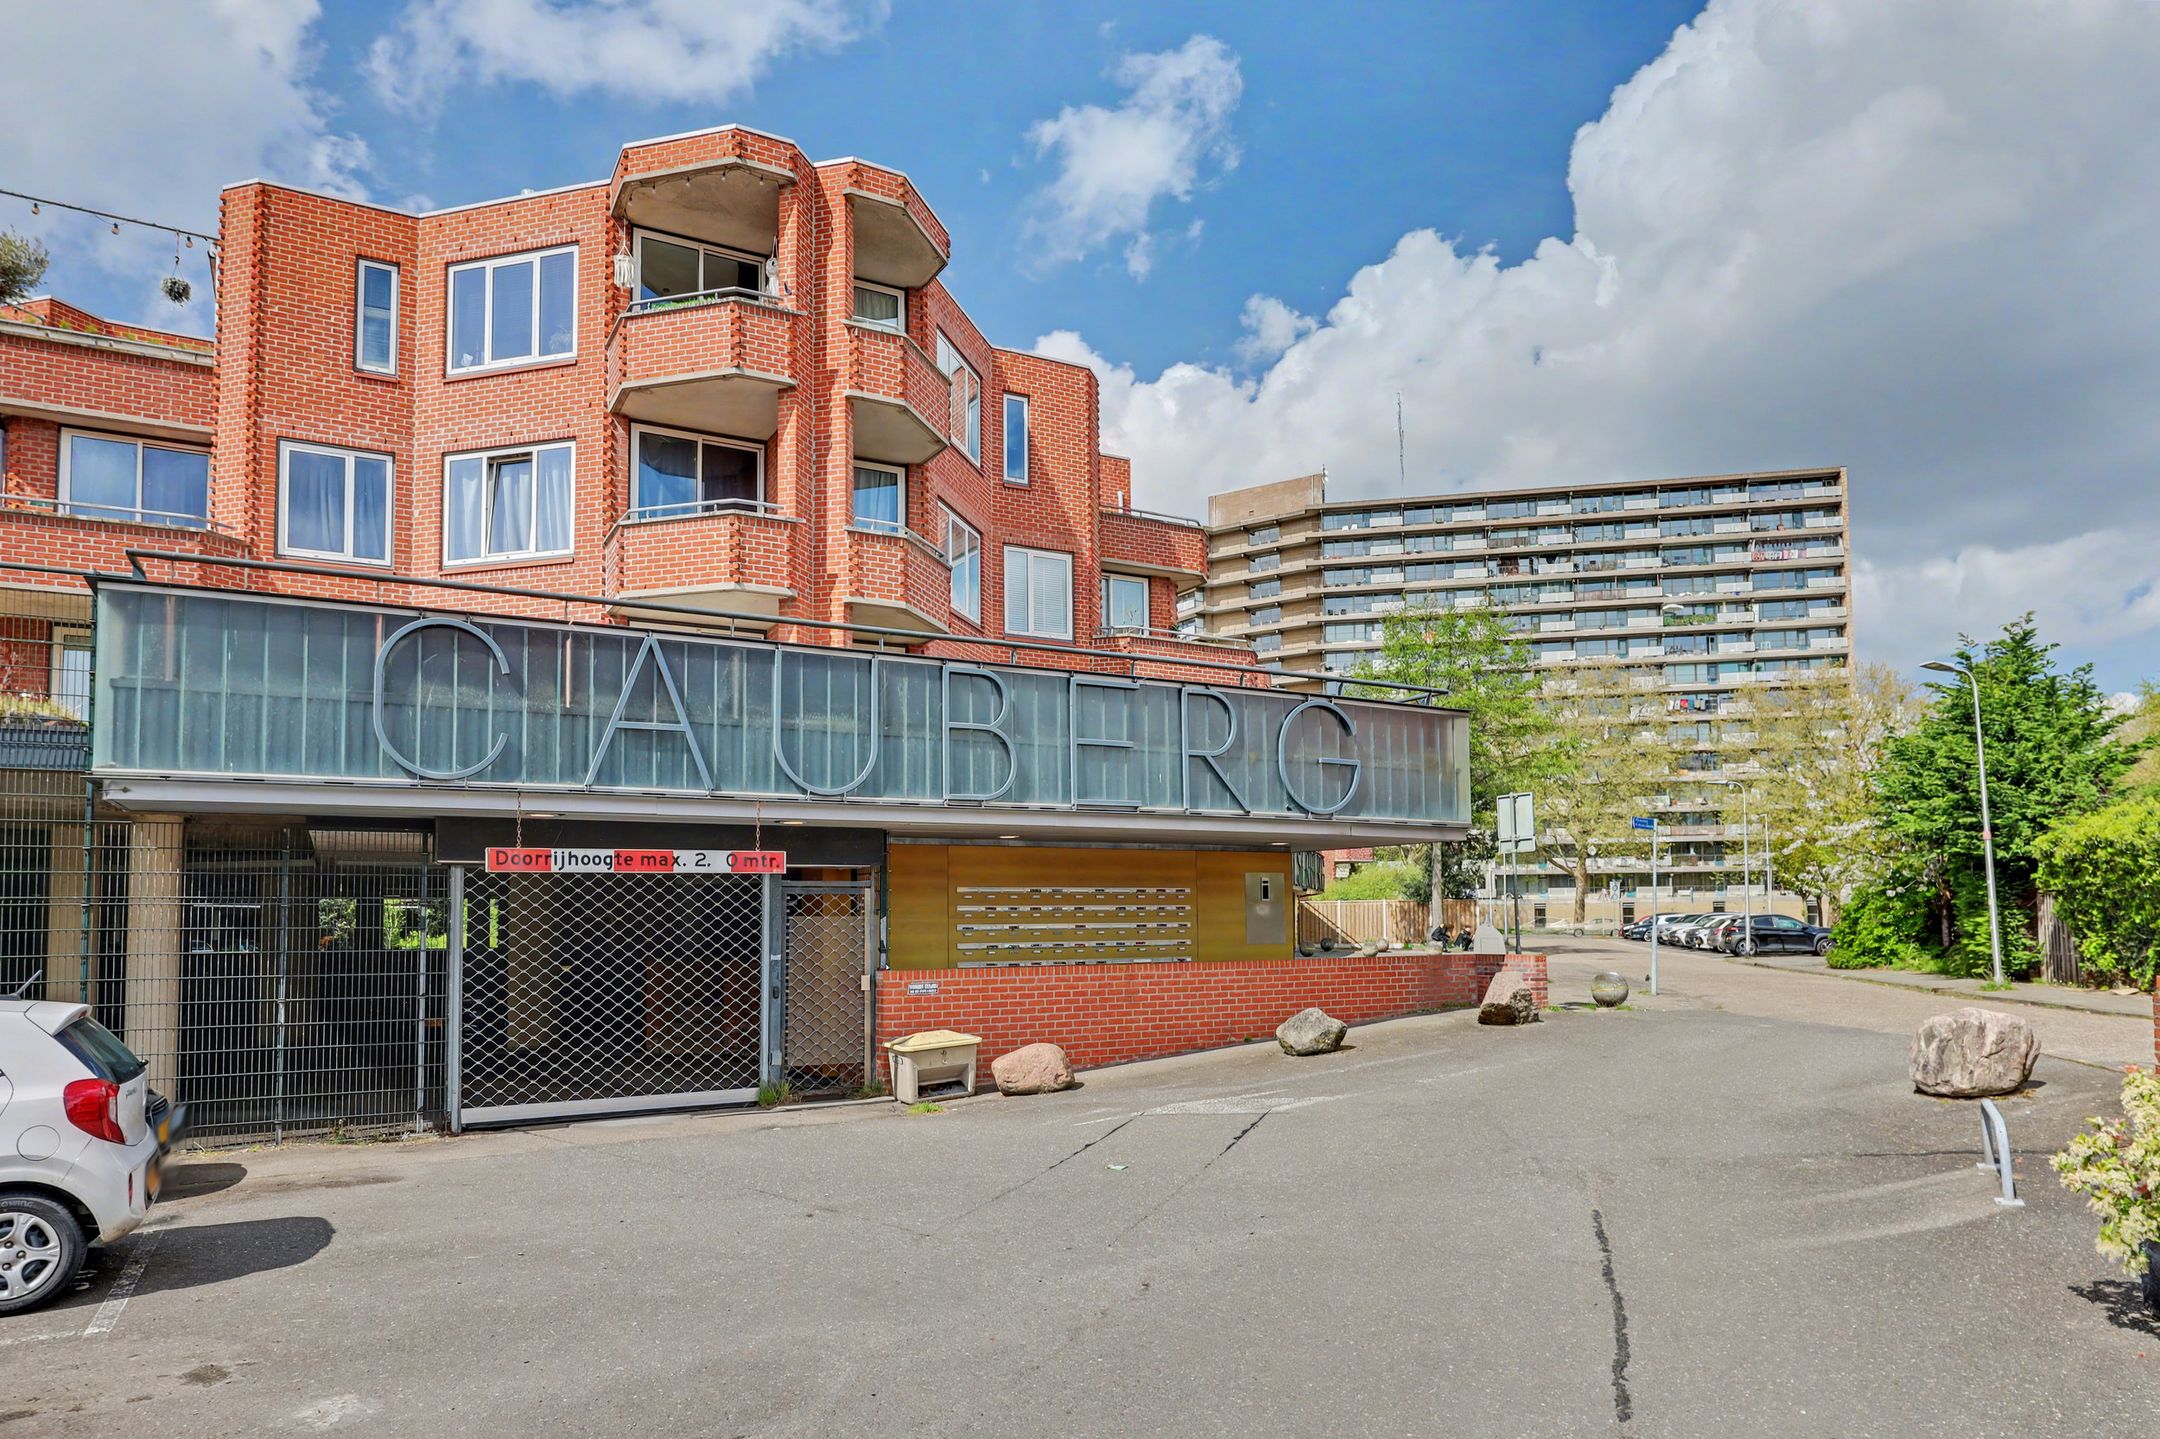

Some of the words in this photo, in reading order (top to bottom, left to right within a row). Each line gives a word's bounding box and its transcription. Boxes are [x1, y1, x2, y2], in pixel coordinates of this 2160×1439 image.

[373, 616, 1362, 815] CAUBERG
[495, 850, 634, 871] Doorrijhoogte
[640, 854, 687, 867] max.
[743, 855, 780, 868] mtr.
